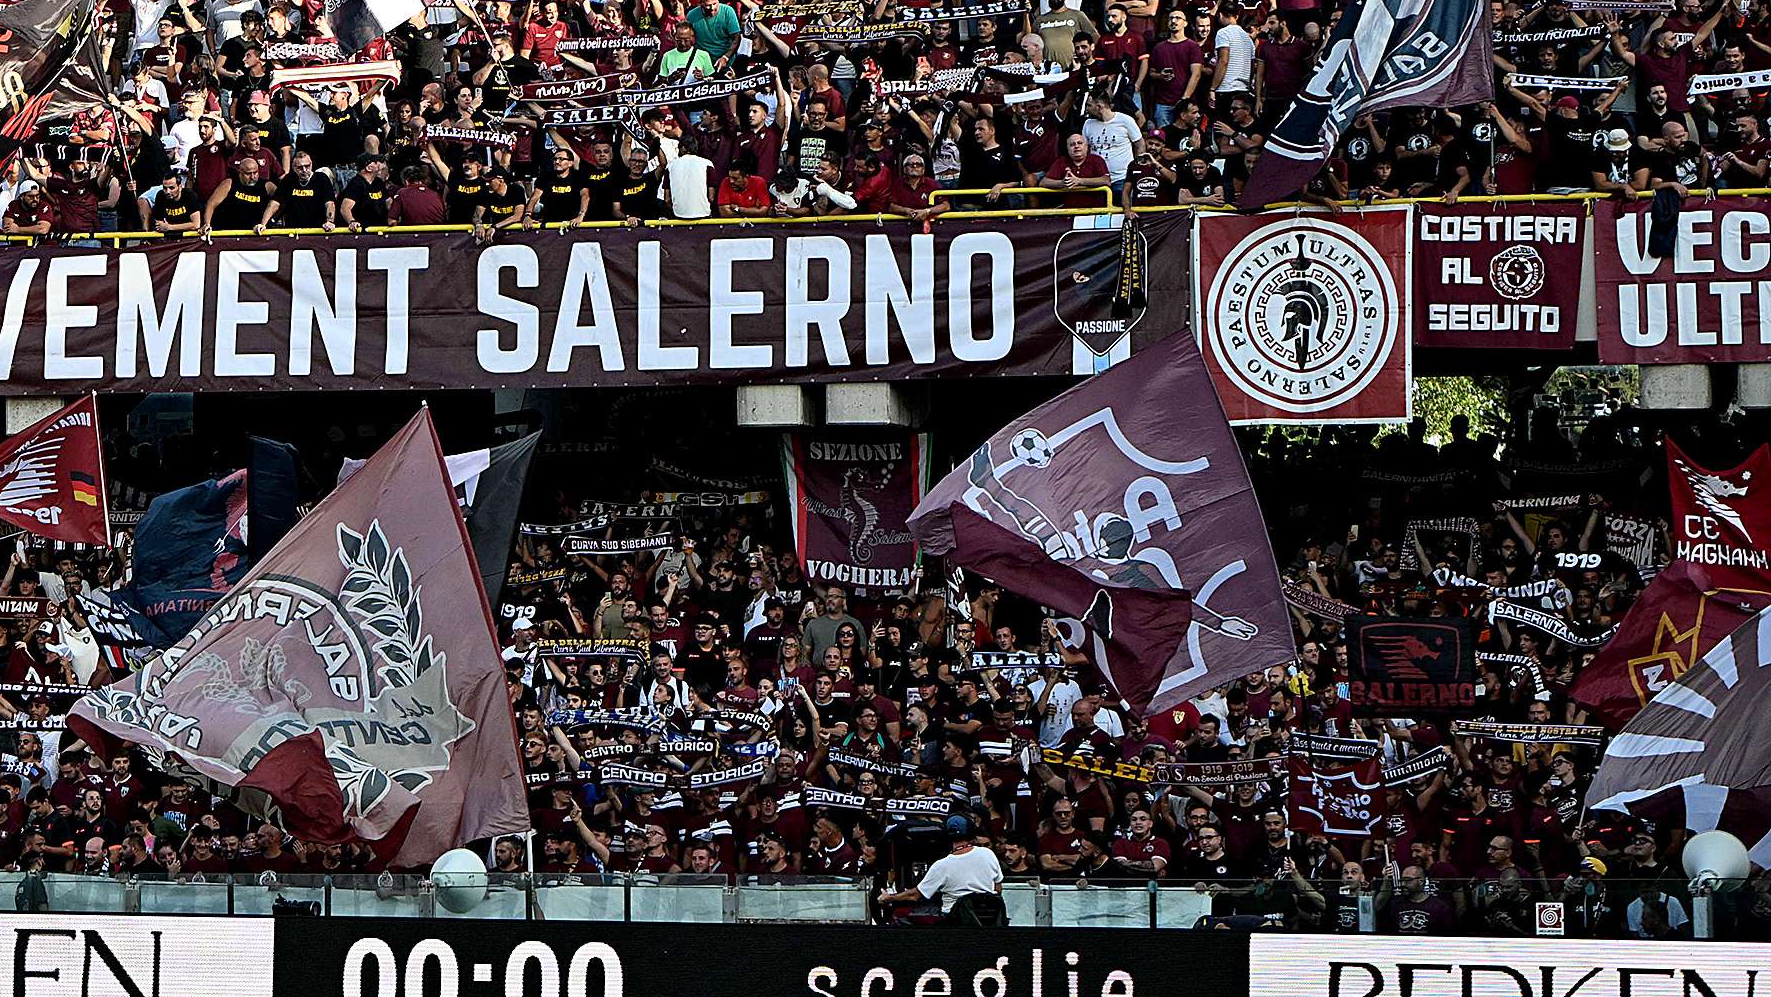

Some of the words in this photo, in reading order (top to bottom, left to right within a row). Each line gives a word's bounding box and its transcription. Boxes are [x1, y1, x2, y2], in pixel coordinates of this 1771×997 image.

[632, 89, 679, 106] PIAZZA
[1421, 214, 1577, 245] COSTIERA
[1308, 240, 1378, 320] ULTRAS
[1441, 257, 1483, 285] AL
[475, 231, 1015, 374] SALERNO
[1228, 240, 1292, 350] PAESTUM
[1075, 319, 1126, 335] PASSIONE
[1429, 304, 1561, 333] SEGUITO
[1248, 351, 1362, 394] SALERNO
[810, 442, 903, 462] SEZIONE
[572, 540, 599, 551] CURVA
[601, 539, 619, 550] SUD
[806, 560, 910, 587] VOGHERA
[1555, 553, 1602, 569] 1919
[1351, 681, 1474, 706] SALERNO
[720, 710, 771, 732] STORICO
[584, 744, 633, 758] CENTRO
[659, 741, 714, 753] STORICO
[600, 767, 667, 784] CENTRO
[690, 761, 765, 786] STORICO
[1200, 765, 1223, 774] 1919
[1231, 763, 1255, 773] 2019
[805, 789, 866, 807] CENTRO
[886, 798, 950, 814] STORICO
[342, 937, 624, 997] 00:00
